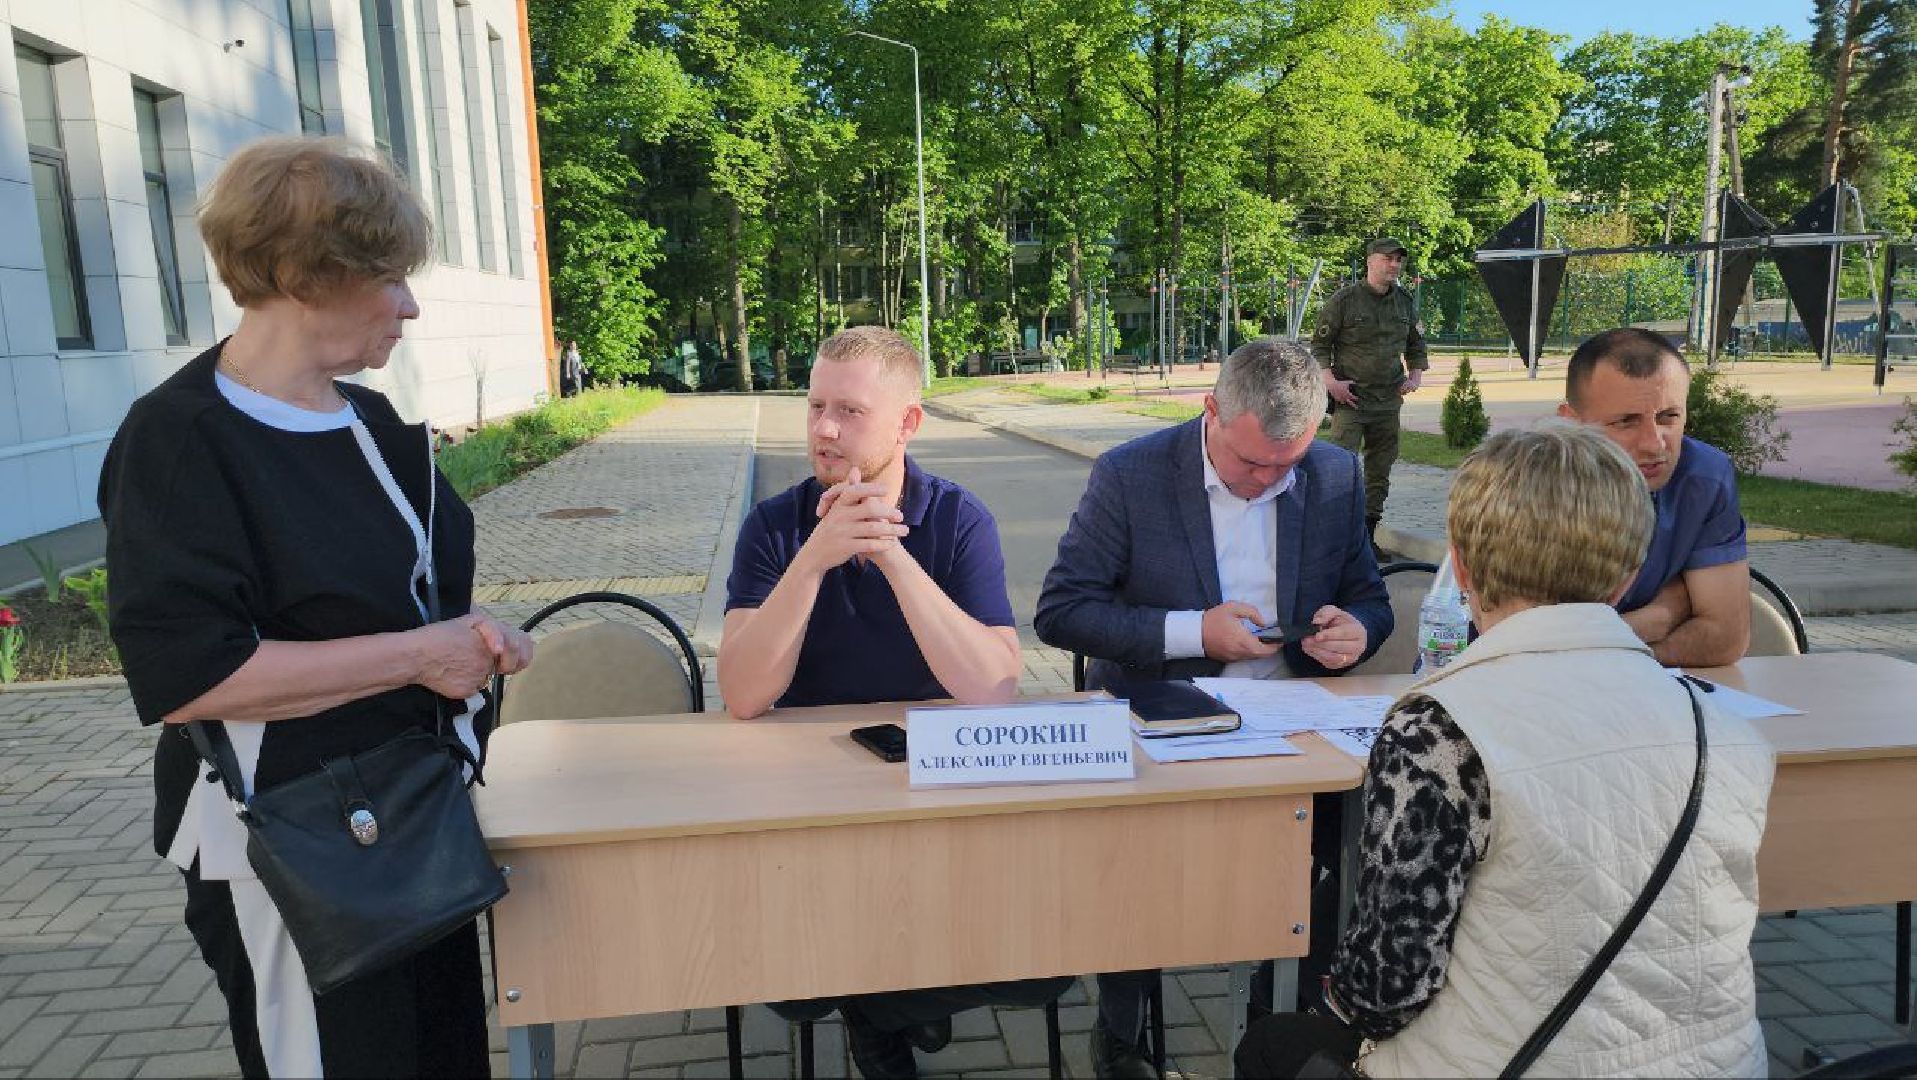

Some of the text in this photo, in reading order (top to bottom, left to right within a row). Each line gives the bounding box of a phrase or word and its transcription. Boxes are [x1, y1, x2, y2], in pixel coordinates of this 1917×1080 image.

[955, 723, 1088, 746] СОРОКИН
[917, 750, 1128, 769] АЛЕКСАНДР ЕВГЕНЬЕВИЧ
